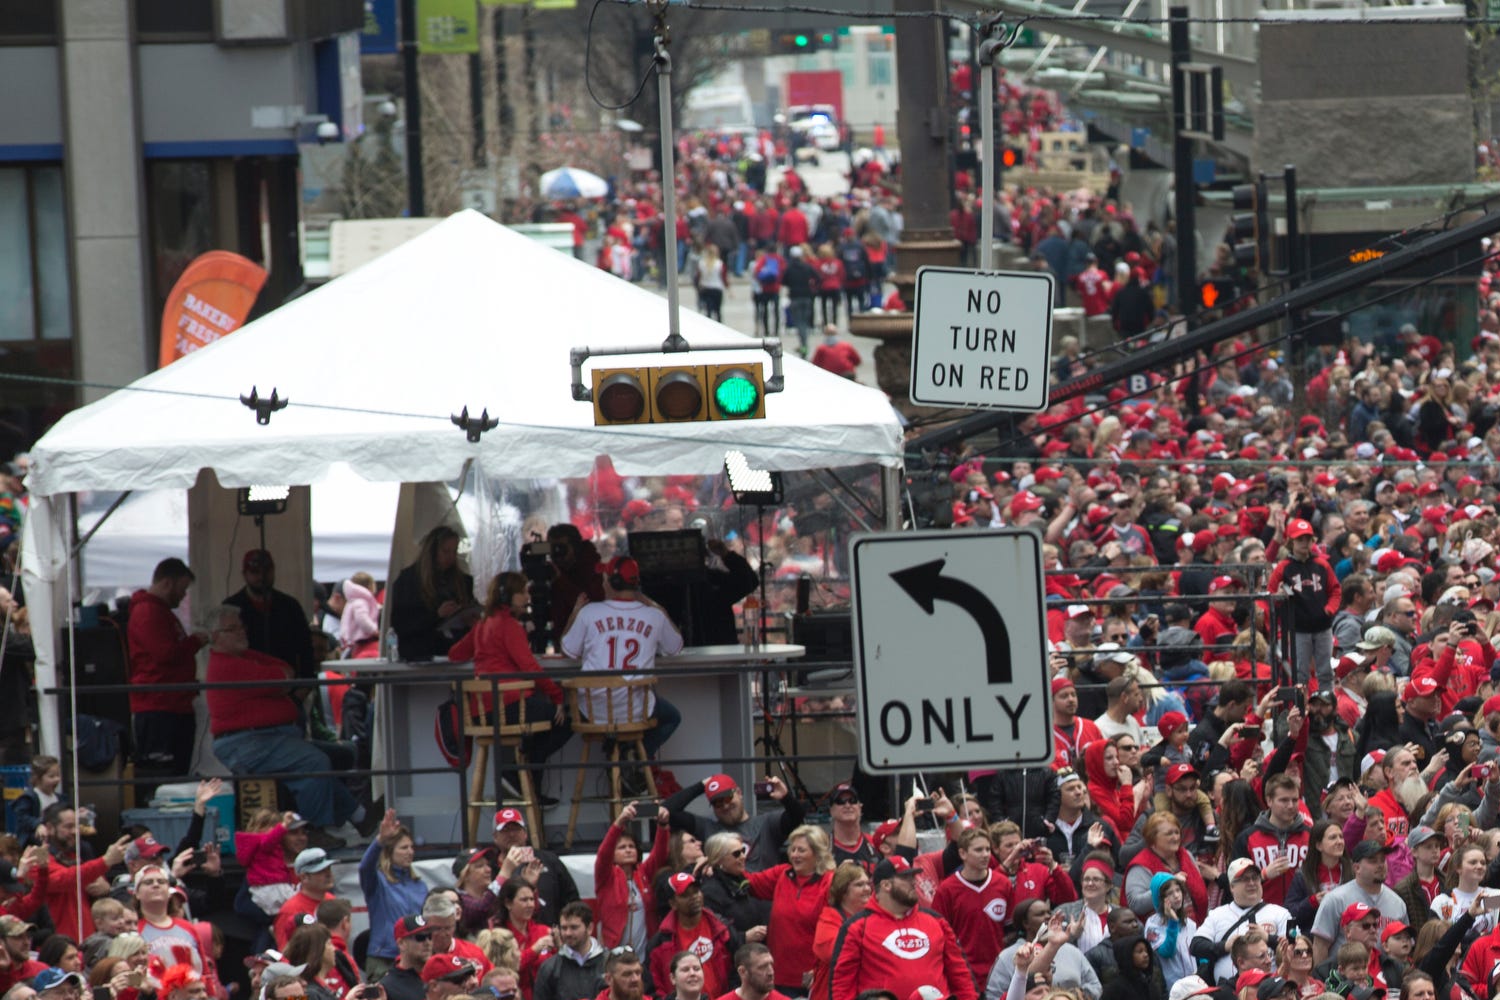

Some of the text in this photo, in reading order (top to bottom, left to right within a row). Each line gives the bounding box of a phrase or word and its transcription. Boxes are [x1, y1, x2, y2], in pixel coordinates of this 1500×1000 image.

[967, 289, 1001, 314] NO
[950, 326, 1016, 353] TURN
[932, 363, 963, 388] ON
[980, 366, 1029, 391] RED
[595, 616, 653, 639] HERZOG
[607, 636, 640, 671] 12
[880, 694, 1031, 746] ONLY
